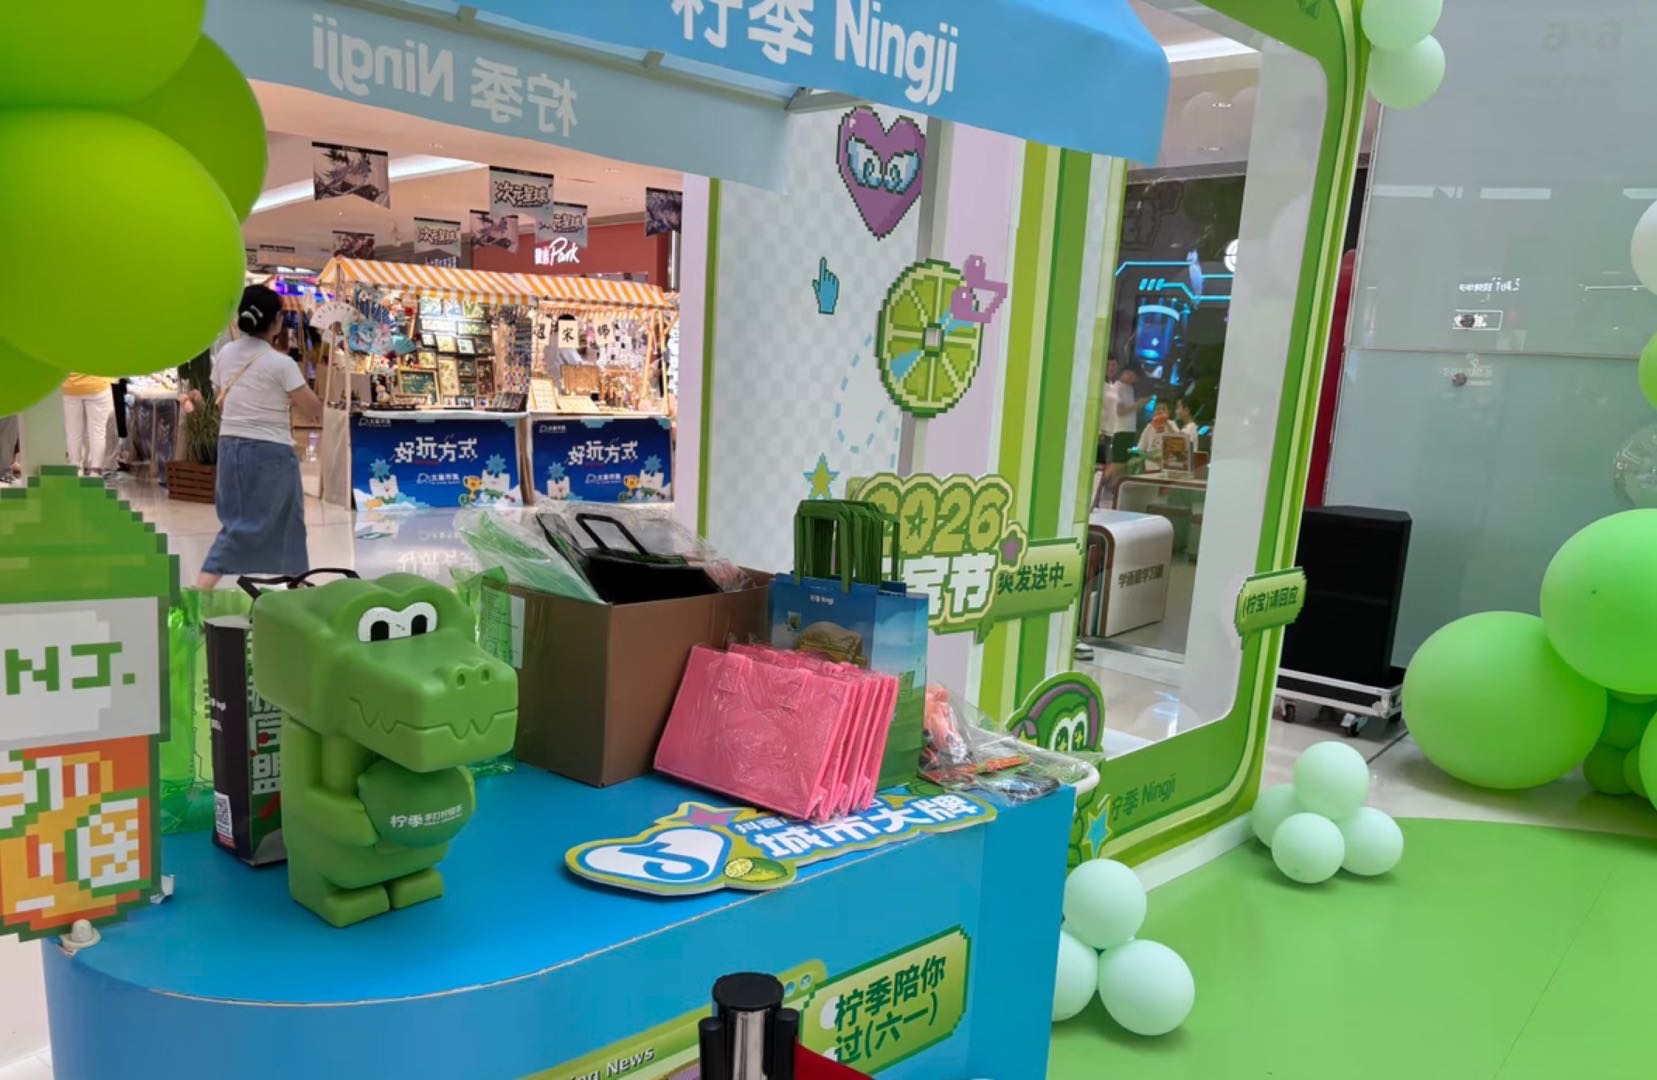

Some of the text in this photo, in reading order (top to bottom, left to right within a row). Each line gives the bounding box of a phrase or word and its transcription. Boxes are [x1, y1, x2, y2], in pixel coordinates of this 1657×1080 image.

[835, 0, 958, 106] Ningji
[539, 212, 584, 233] 元星球
[394, 436, 479, 463] 好玩方式
[568, 440, 639, 465] 好玩方式
[882, 554, 997, 616] 宝节
[754, 794, 979, 858] 城市大牌
[834, 955, 947, 1032] 柠季陪你
[607, 1047, 655, 1077] News
